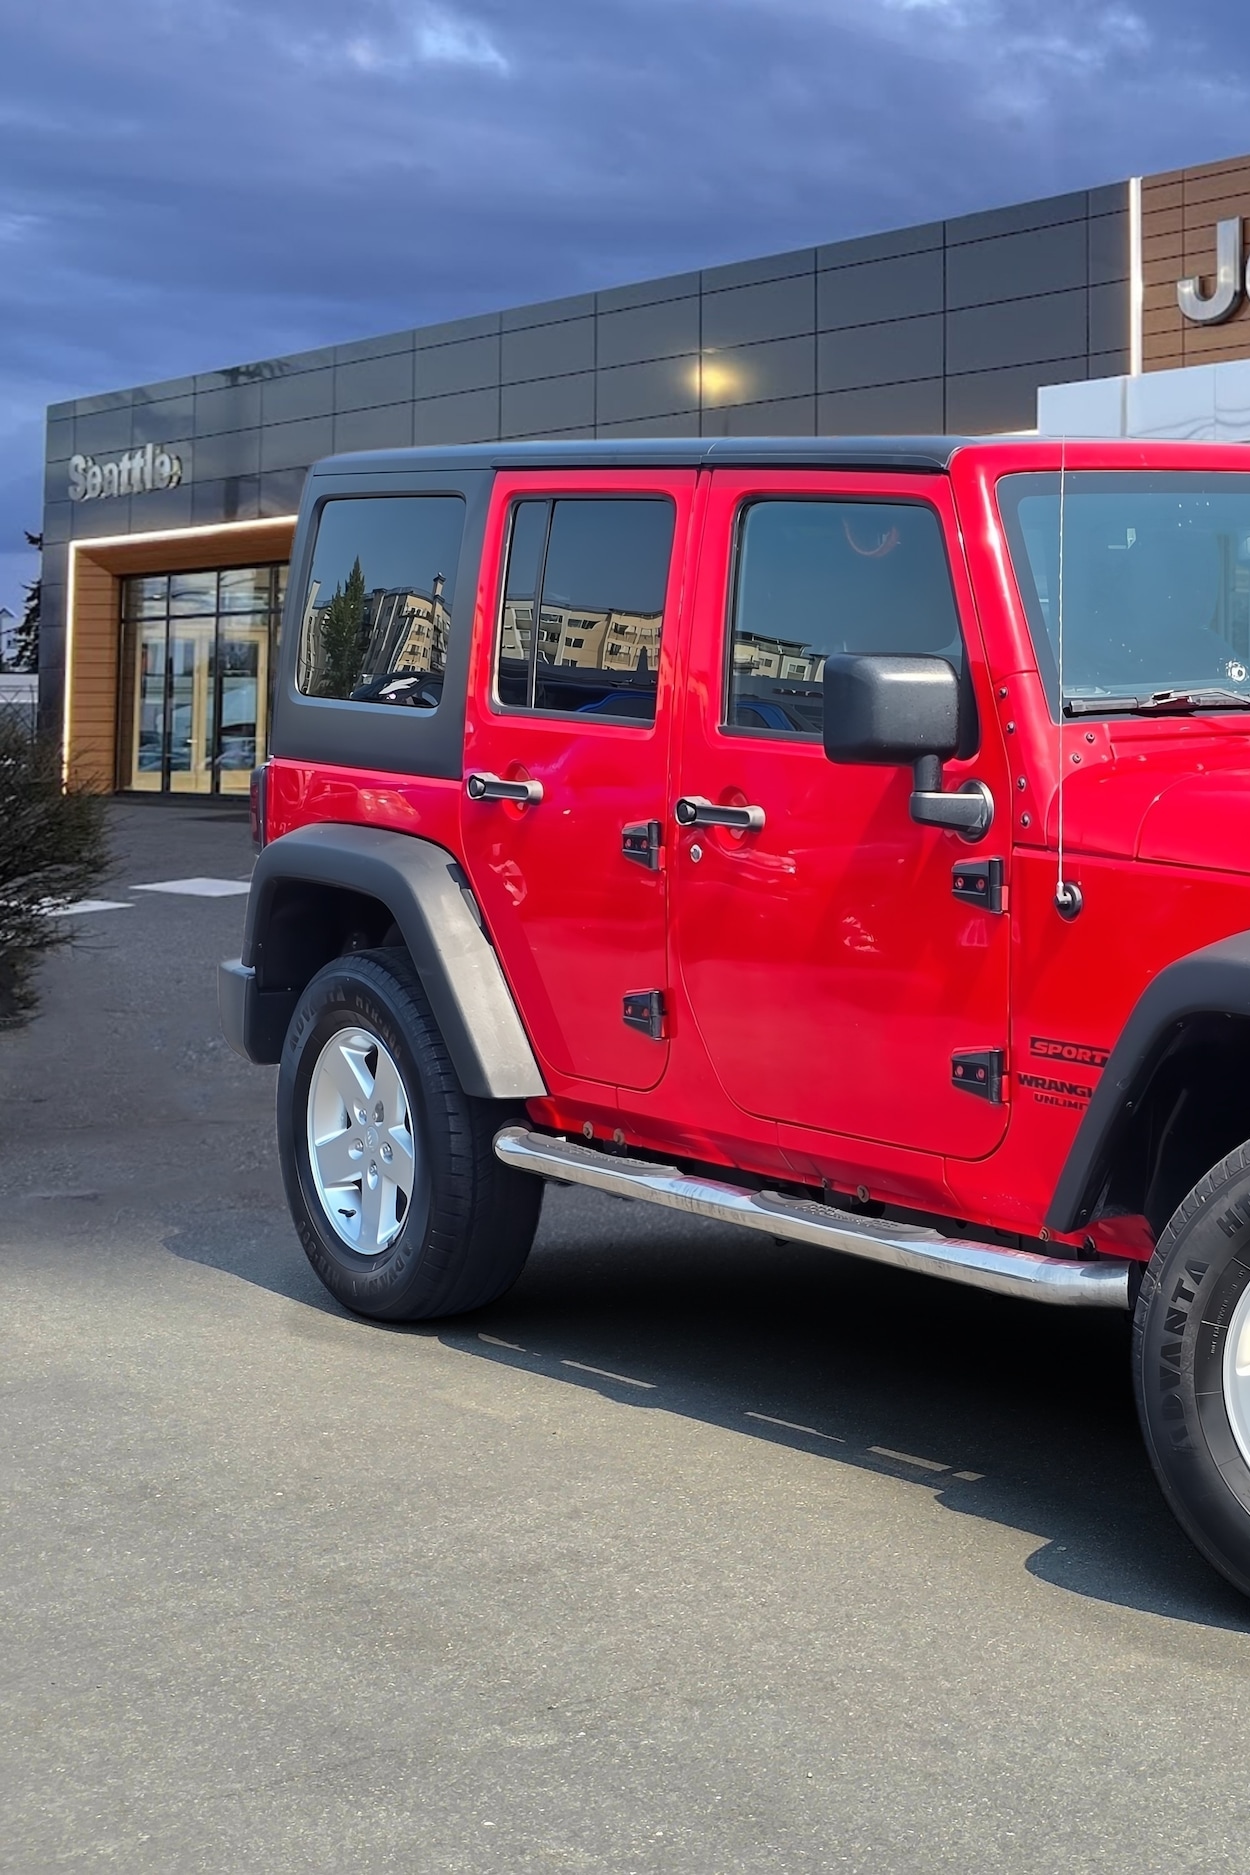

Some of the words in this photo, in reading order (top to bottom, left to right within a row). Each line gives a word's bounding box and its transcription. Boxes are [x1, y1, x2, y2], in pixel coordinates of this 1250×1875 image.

[68, 443, 181, 502] Seattle
[1031, 1040, 1111, 1064] SPORT
[1158, 1259, 1211, 1452] ADVANTA
